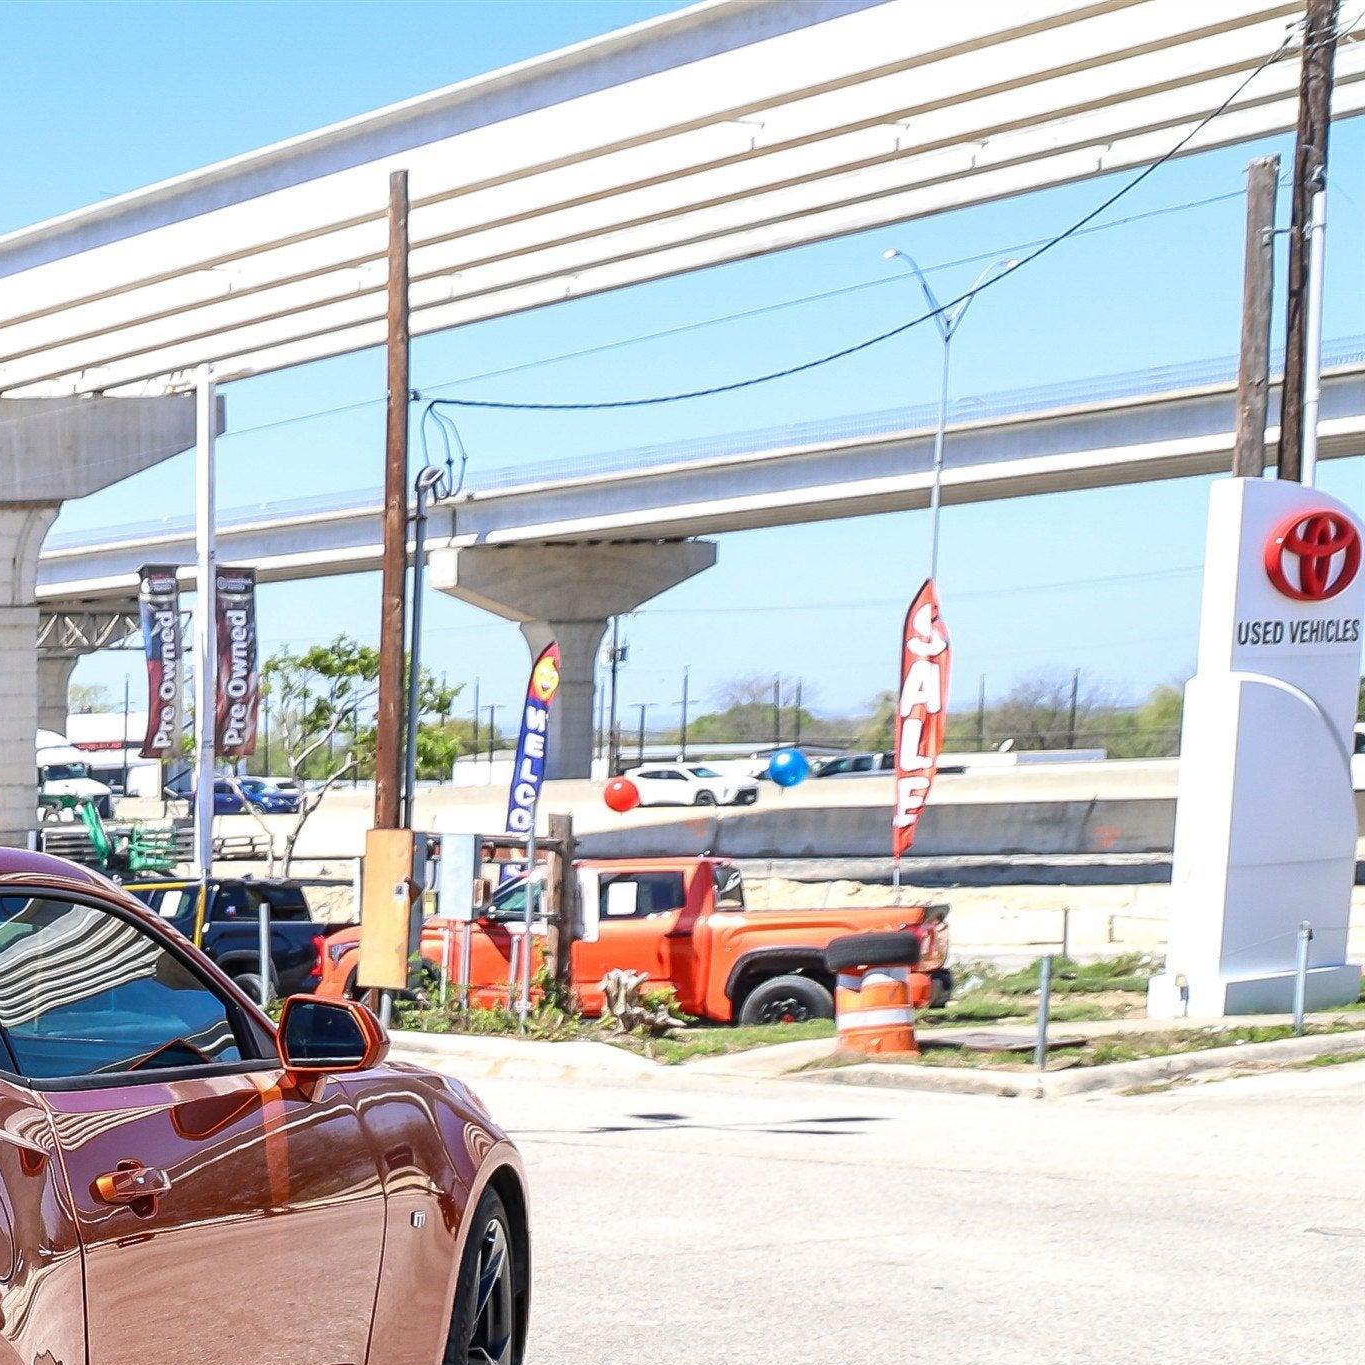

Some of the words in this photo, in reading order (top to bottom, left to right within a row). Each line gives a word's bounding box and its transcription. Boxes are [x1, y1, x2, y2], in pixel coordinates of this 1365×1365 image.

[155, 610, 175, 700] Owned
[228, 610, 248, 698] Owned
[1238, 620, 1285, 646] USED
[1290, 617, 1360, 644] VEHICLES
[153, 705, 175, 748] Pre
[224, 703, 247, 746] Pre
[892, 603, 949, 829] SALE
[509, 706, 547, 831] WELCO
